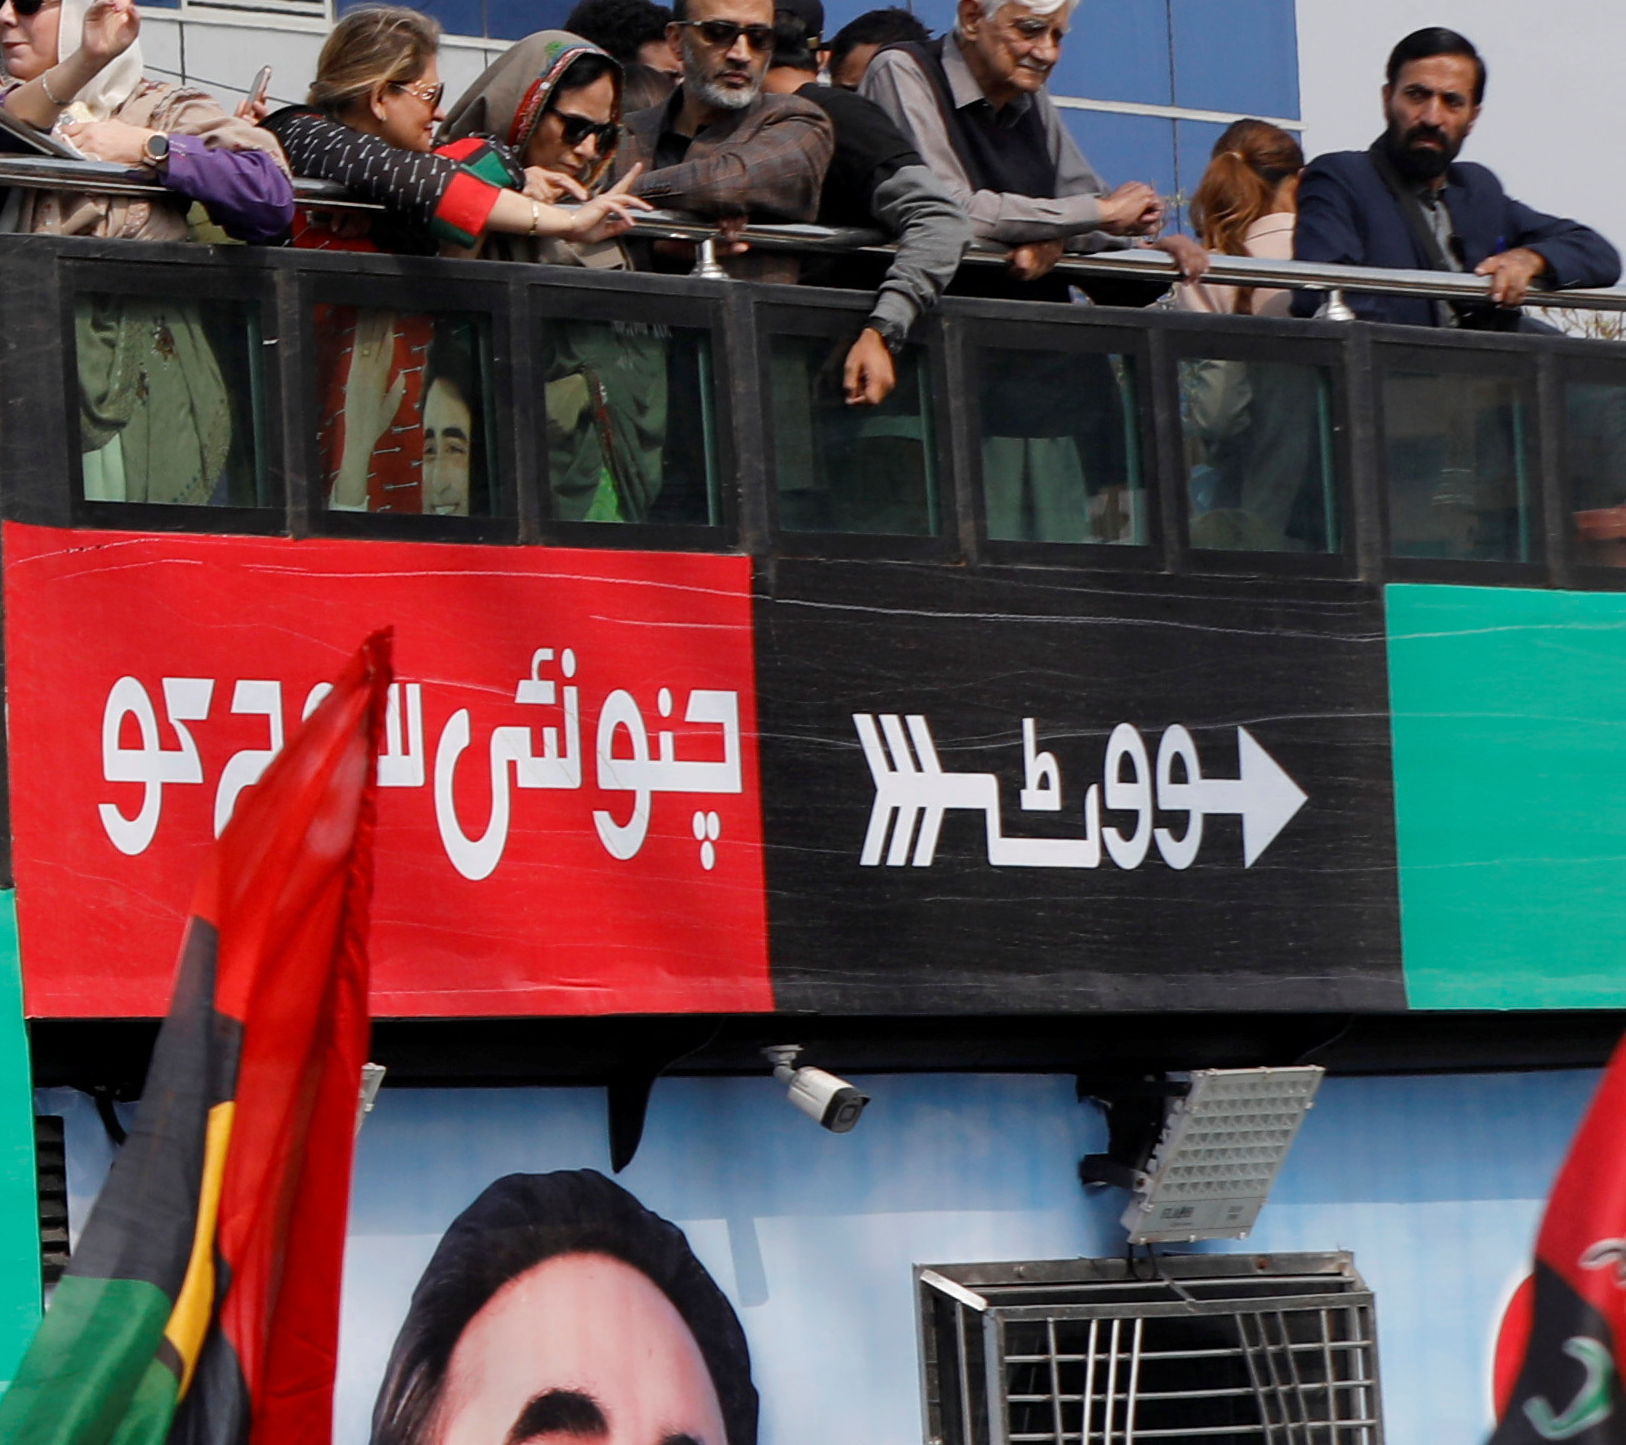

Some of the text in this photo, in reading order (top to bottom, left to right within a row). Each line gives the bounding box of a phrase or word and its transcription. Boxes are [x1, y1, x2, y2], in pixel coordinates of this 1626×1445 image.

[98, 676, 215, 855] کو
[434, 647, 580, 880] نئی
[593, 688, 741, 870] چنو
